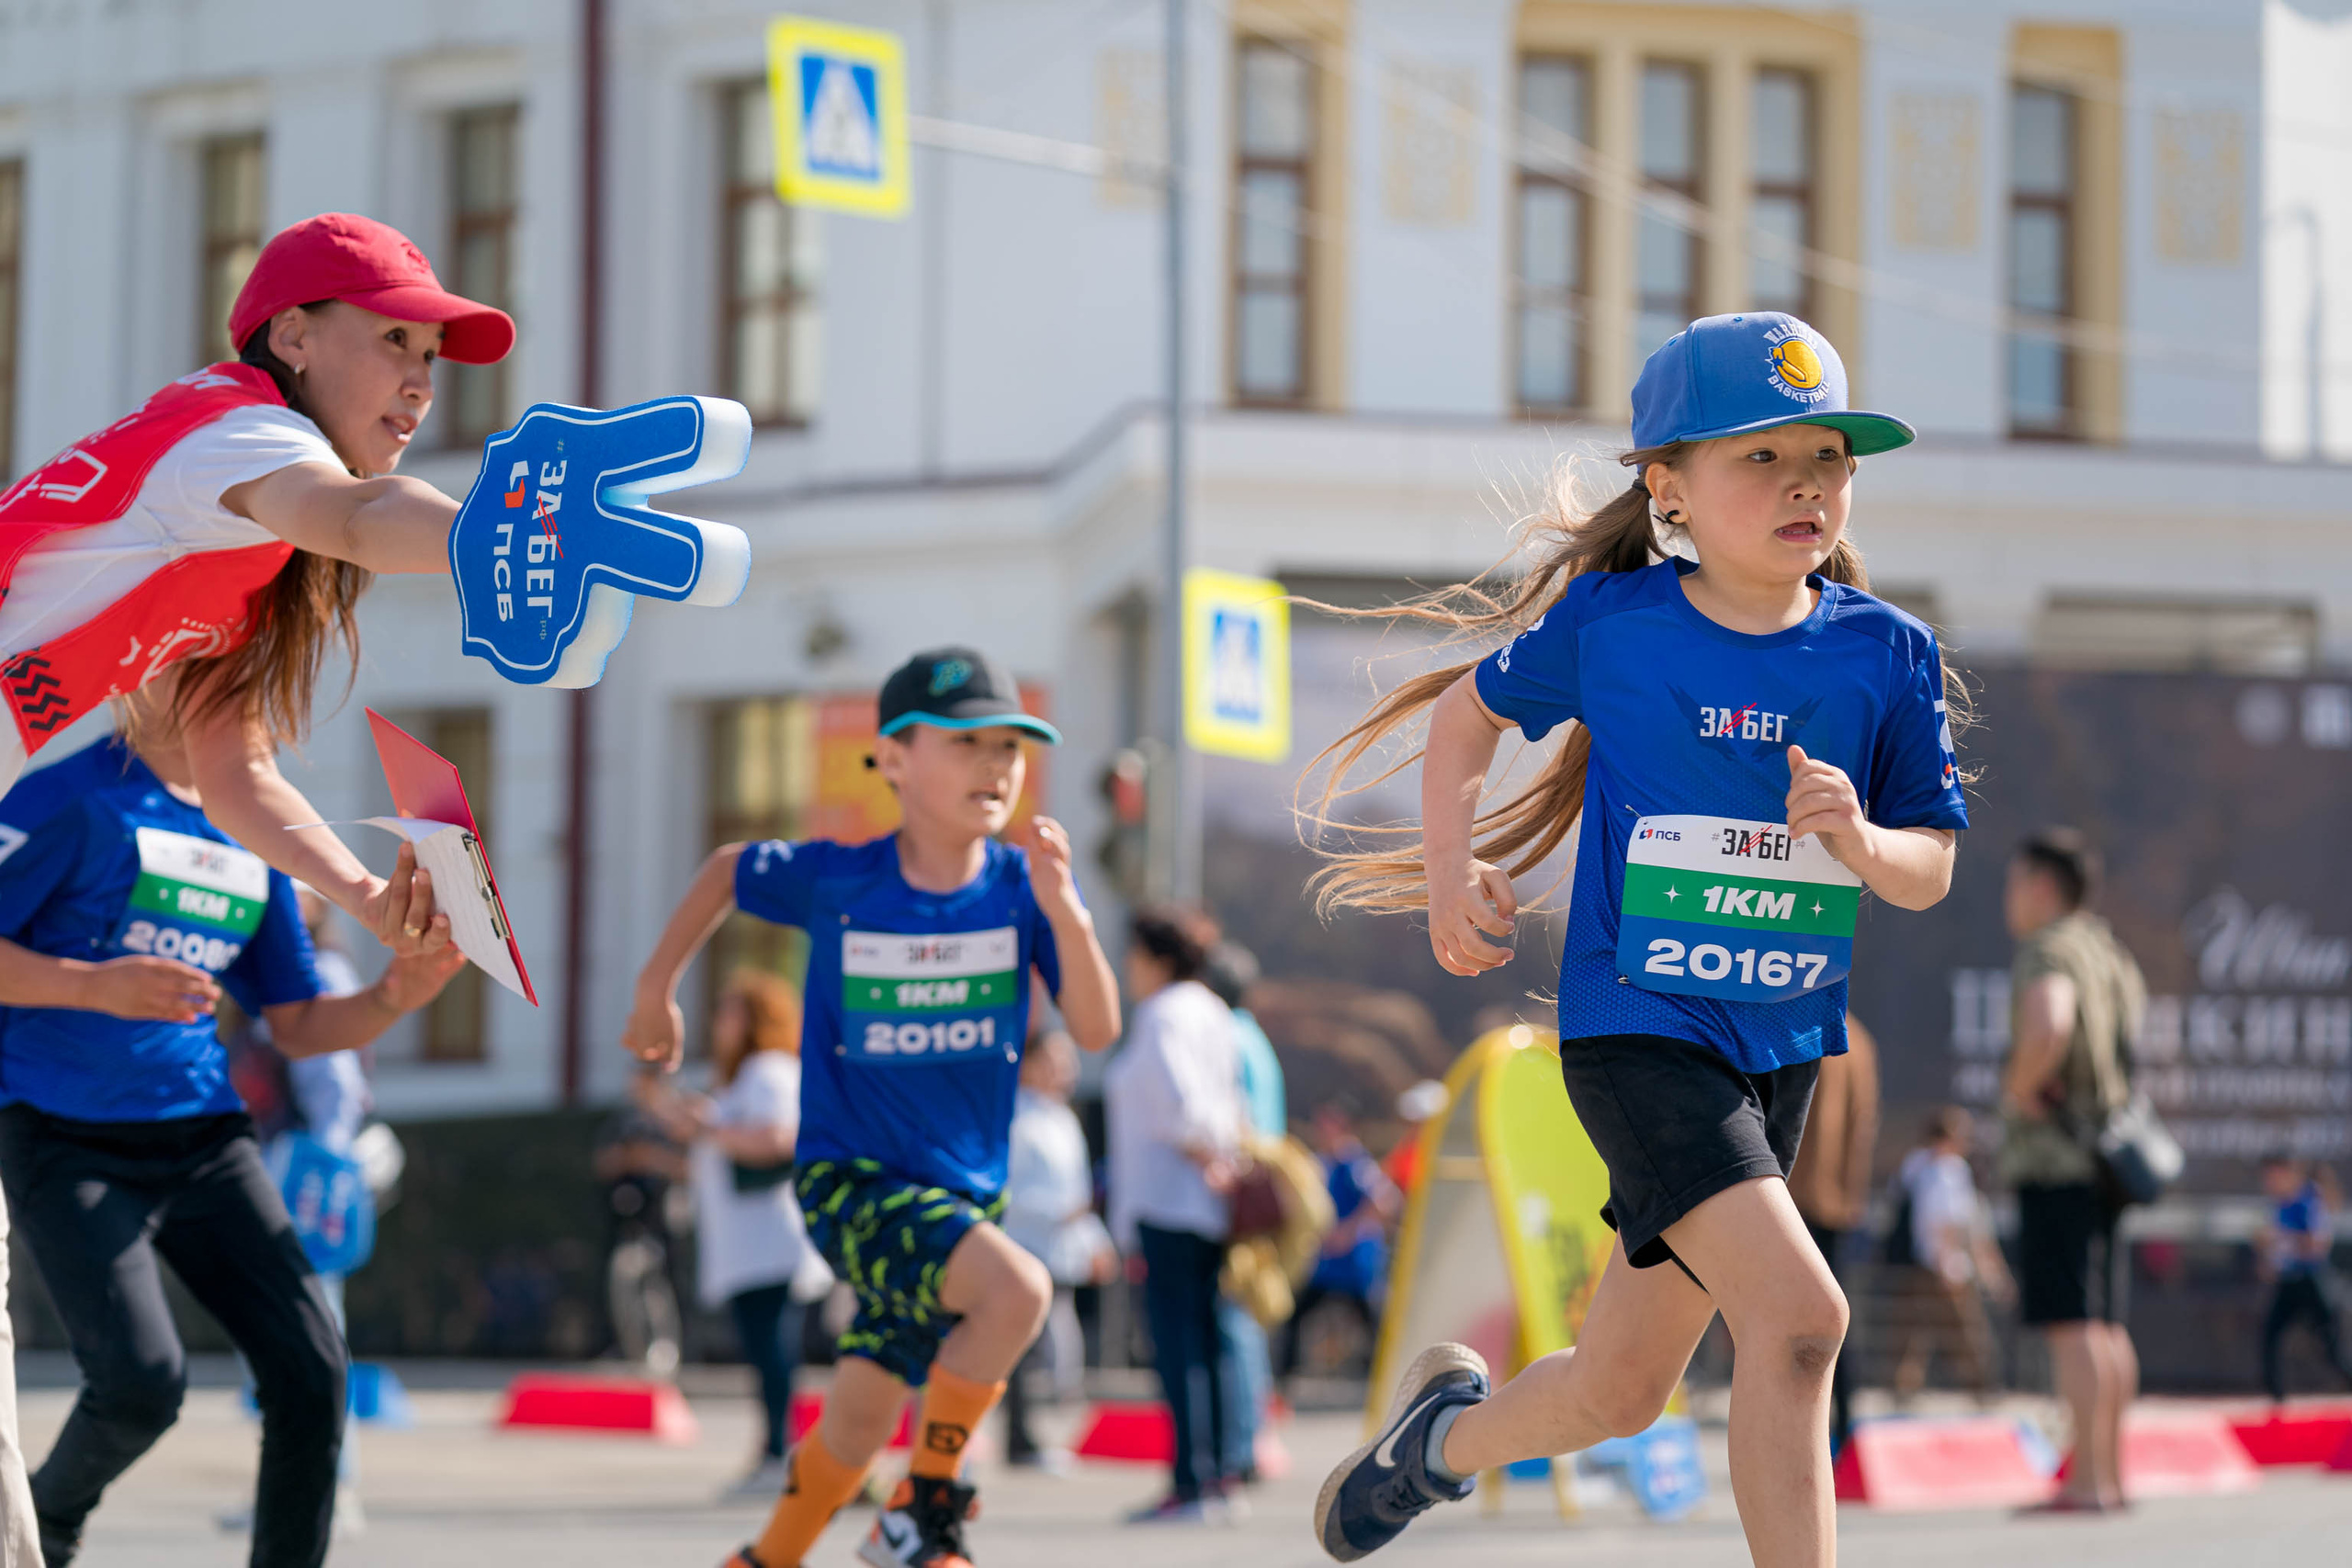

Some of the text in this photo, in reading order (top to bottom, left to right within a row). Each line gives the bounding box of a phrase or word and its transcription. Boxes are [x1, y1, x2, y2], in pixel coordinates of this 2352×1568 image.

[1763, 323, 1818, 350] WARRIS
[1767, 374, 1831, 405] BASKETBALL
[493, 523, 514, 623] ПСБ
[1655, 829, 1681, 842] ПСБ
[1645, 938, 1828, 989] 20167
[864, 1016, 995, 1055] 20101
